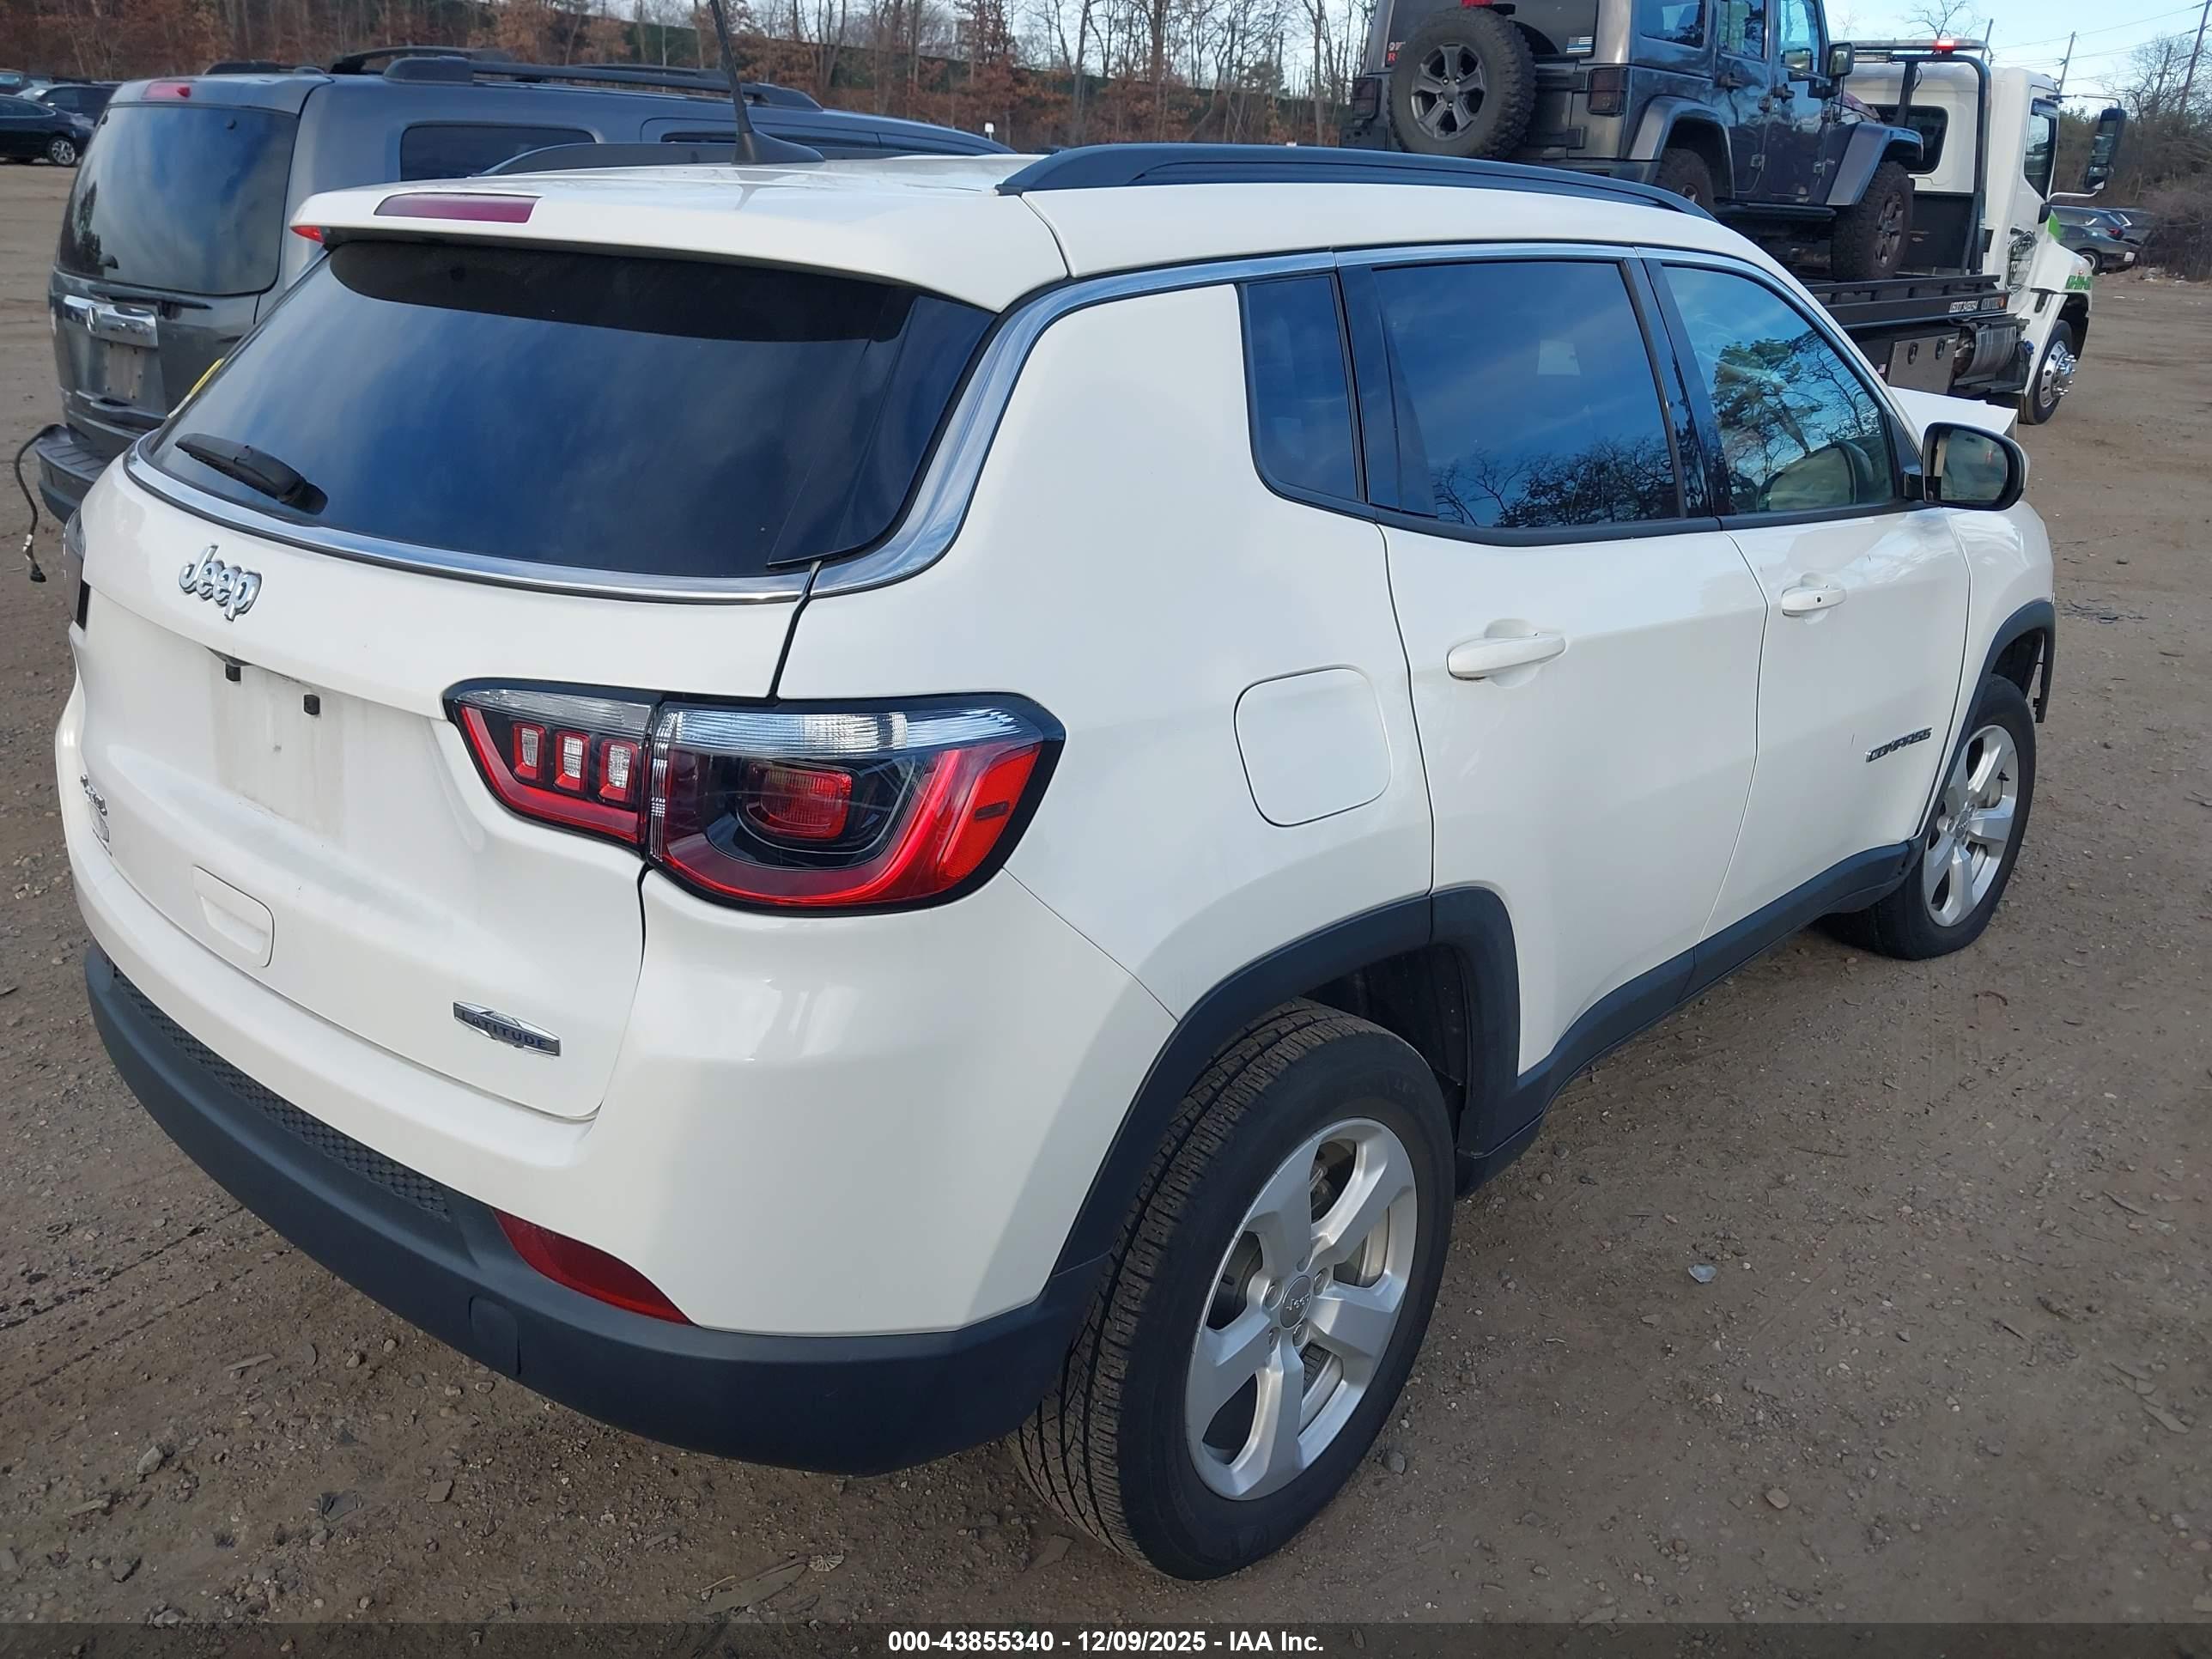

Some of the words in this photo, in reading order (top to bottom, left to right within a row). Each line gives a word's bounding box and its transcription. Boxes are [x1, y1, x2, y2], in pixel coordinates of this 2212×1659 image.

[179, 544, 262, 623] Jeep
[1866, 726, 1932, 763] COMPASS
[460, 1011, 547, 1049] LATITUDE
